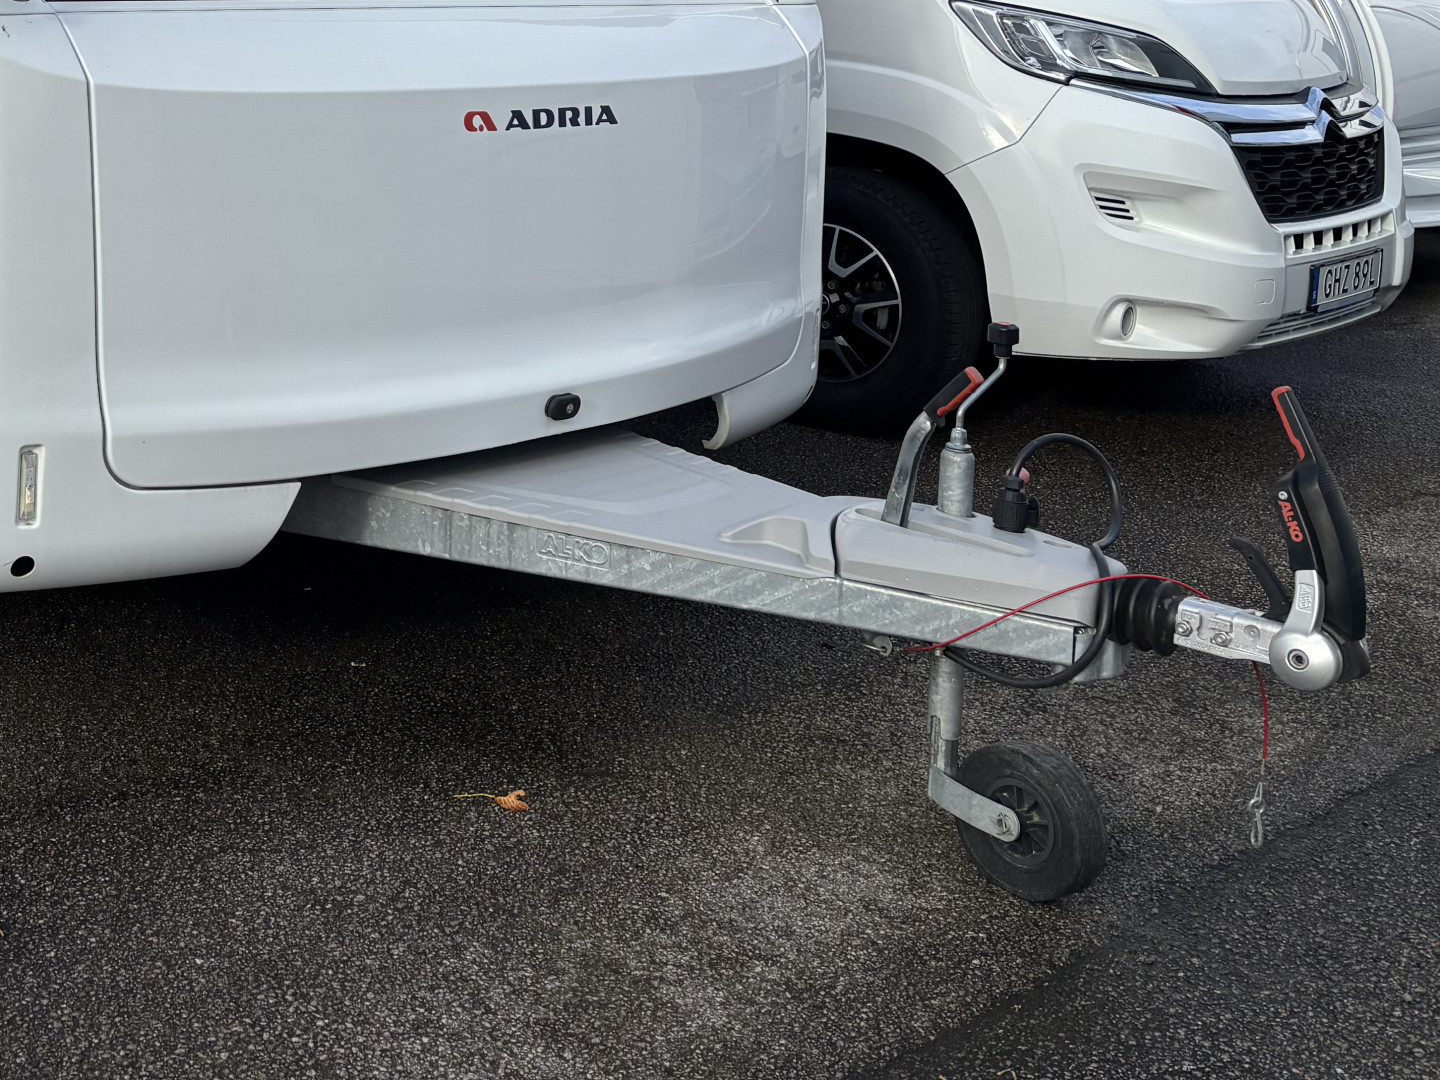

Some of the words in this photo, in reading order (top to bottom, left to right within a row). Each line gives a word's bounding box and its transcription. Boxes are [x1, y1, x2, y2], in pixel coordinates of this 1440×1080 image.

[505, 105, 618, 131] ADRIA
[1324, 264, 1350, 298] GHZ
[1353, 257, 1375, 290] 89L
[1278, 500, 1304, 543] AL-KO
[539, 533, 609, 566] AL-KO
